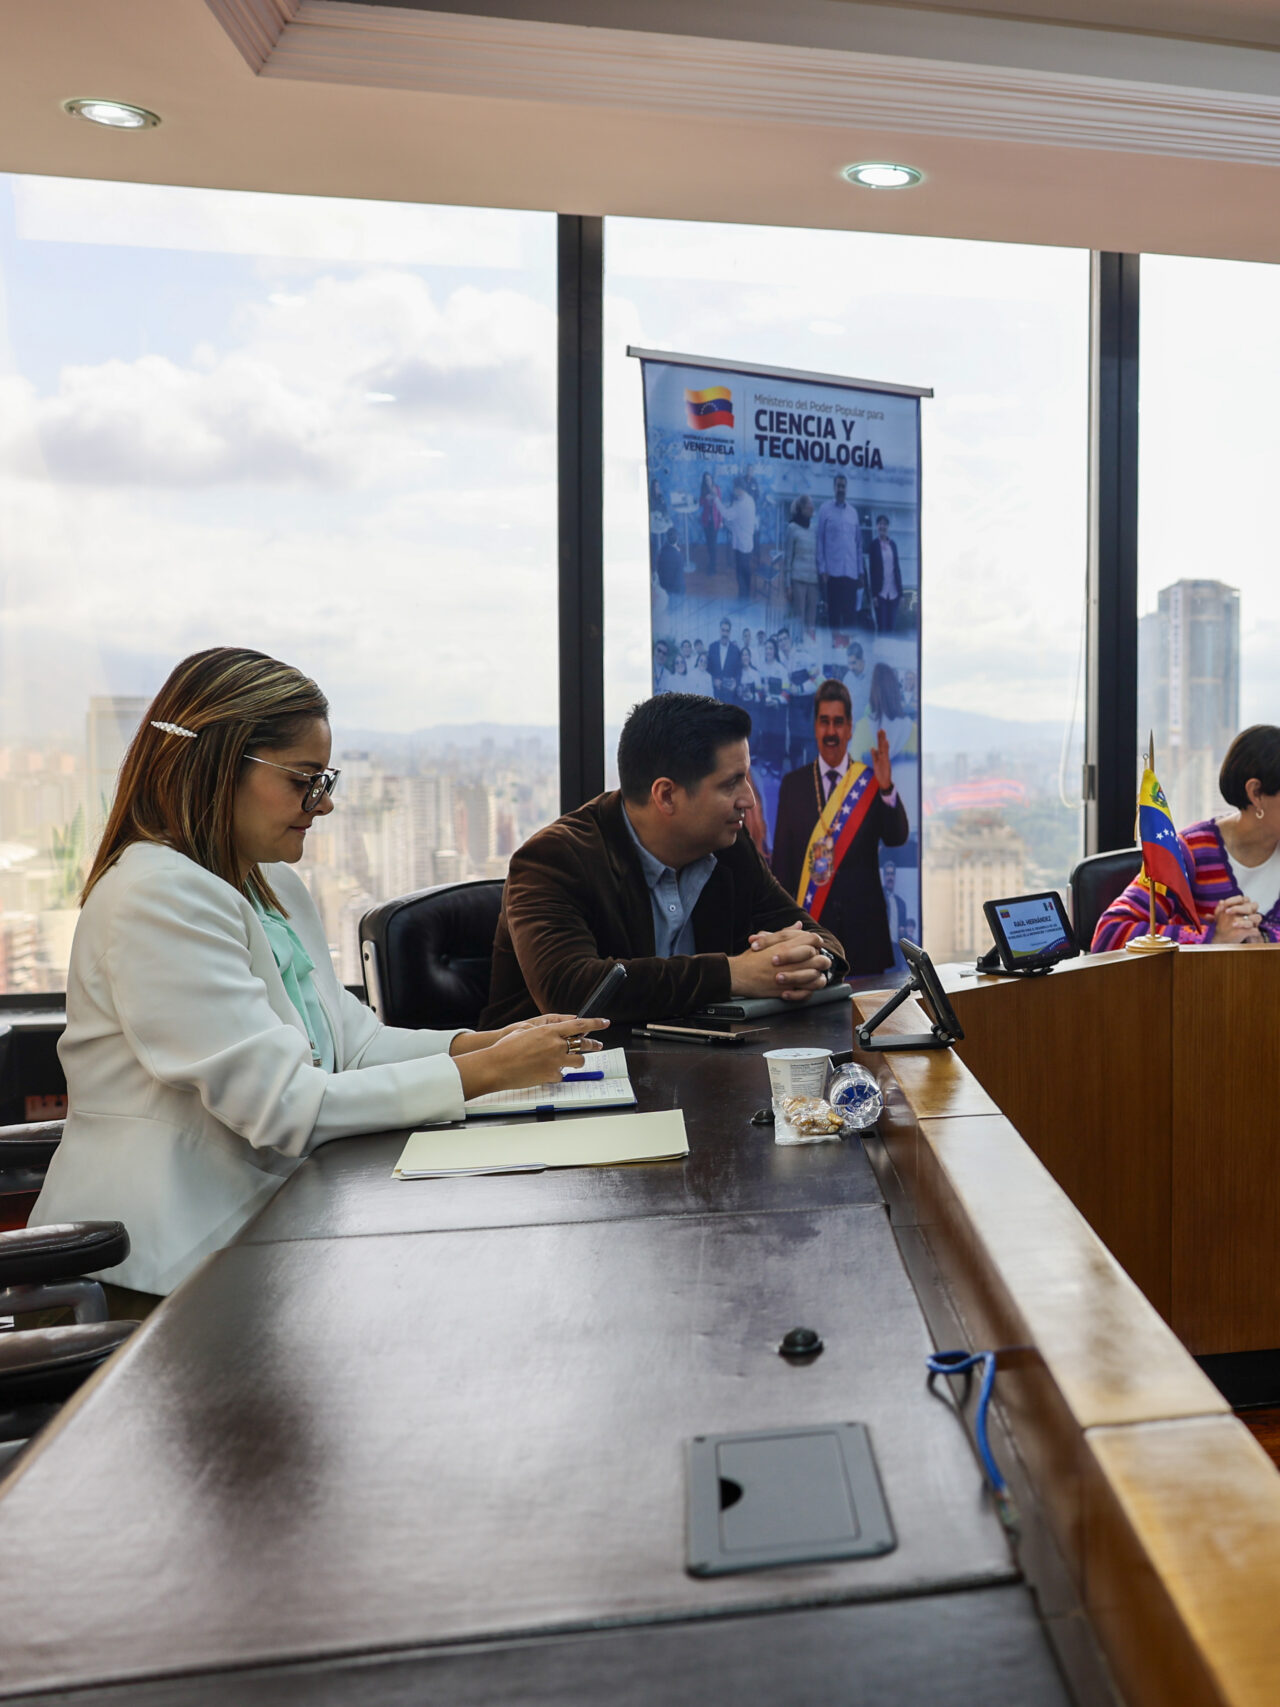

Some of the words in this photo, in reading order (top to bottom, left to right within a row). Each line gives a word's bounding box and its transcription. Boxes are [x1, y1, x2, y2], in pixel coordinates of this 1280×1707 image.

[754, 394, 793, 409] Ministerio
[795, 399, 808, 410] del
[810, 401, 833, 413] Poder
[835, 404, 865, 417] Popular
[866, 409, 885, 421] para
[754, 409, 836, 440] CIENCIA
[842, 419, 855, 441] Y
[683, 440, 735, 456] VENEZUELA
[754, 434, 884, 470] TECNOLOGÍA
[1026, 915, 1052, 925] HERNÁNDEZ
